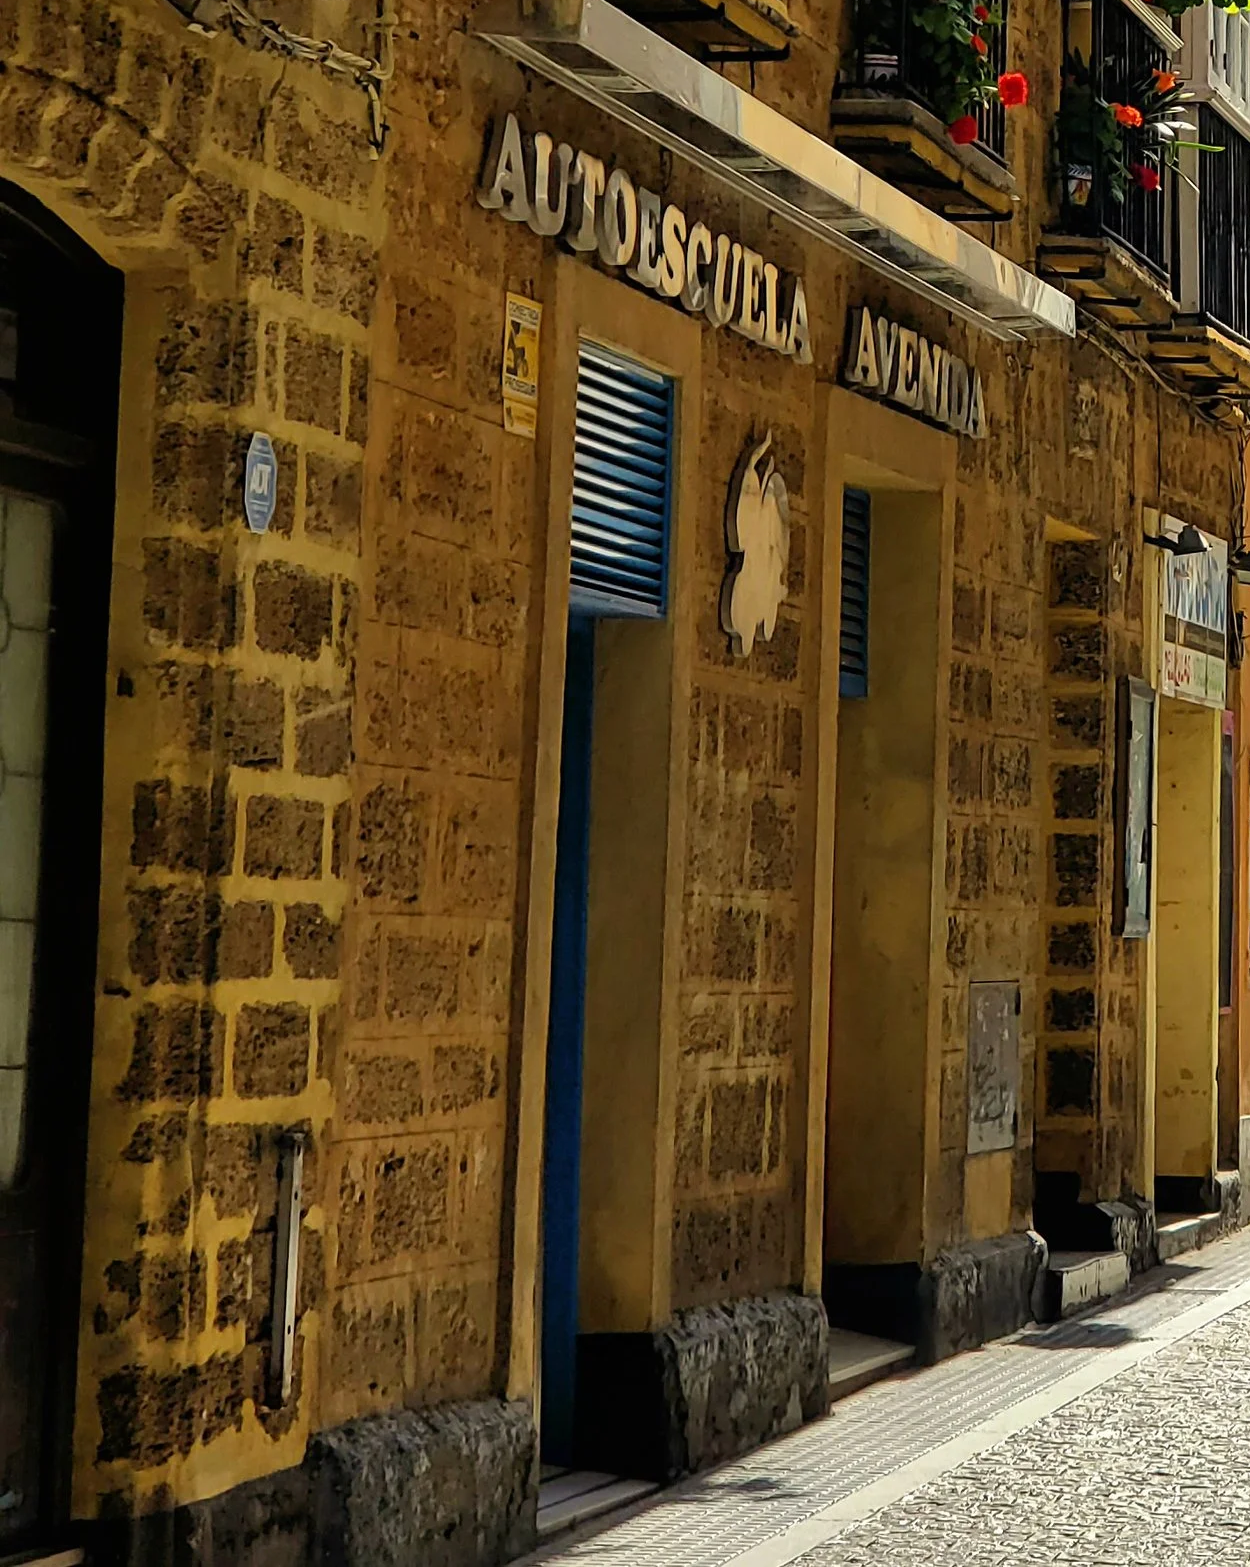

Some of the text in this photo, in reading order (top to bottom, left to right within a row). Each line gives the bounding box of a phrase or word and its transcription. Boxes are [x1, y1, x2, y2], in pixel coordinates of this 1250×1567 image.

[477, 113, 813, 364] AUTOESCUELA
[845, 306, 988, 439] AVENIDA
[249, 463, 272, 496] ADT
